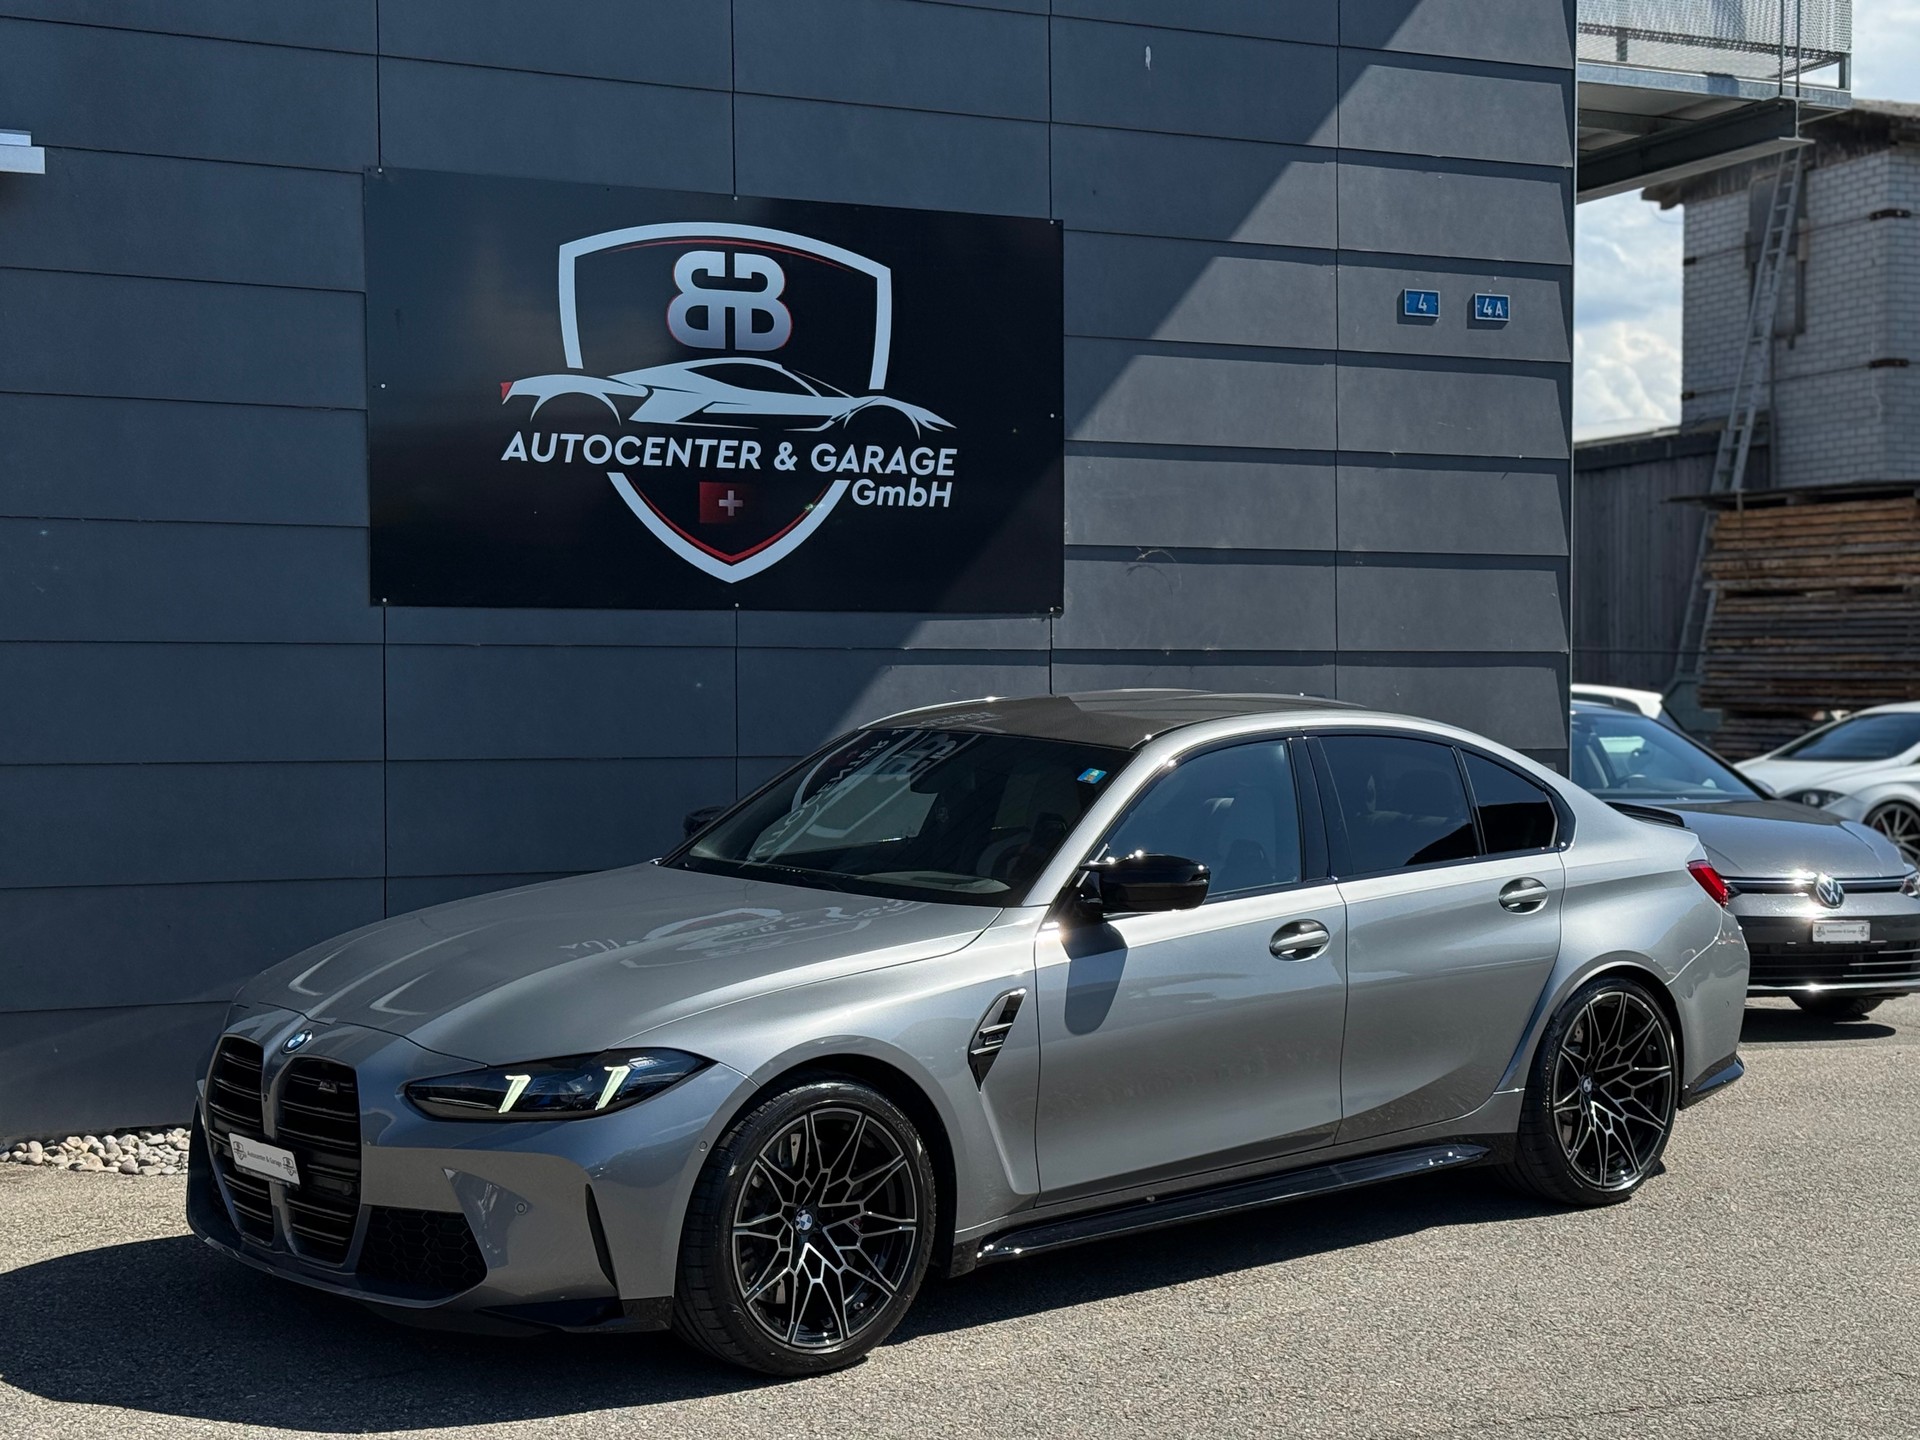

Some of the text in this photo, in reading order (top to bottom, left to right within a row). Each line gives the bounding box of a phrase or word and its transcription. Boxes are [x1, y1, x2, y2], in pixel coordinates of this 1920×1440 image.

[1418, 293, 1428, 311] 4
[1483, 298, 1503, 316] 4A
[501, 431, 957, 476] AUTOCENTER & GARAGE
[851, 478, 953, 508] GmbH
